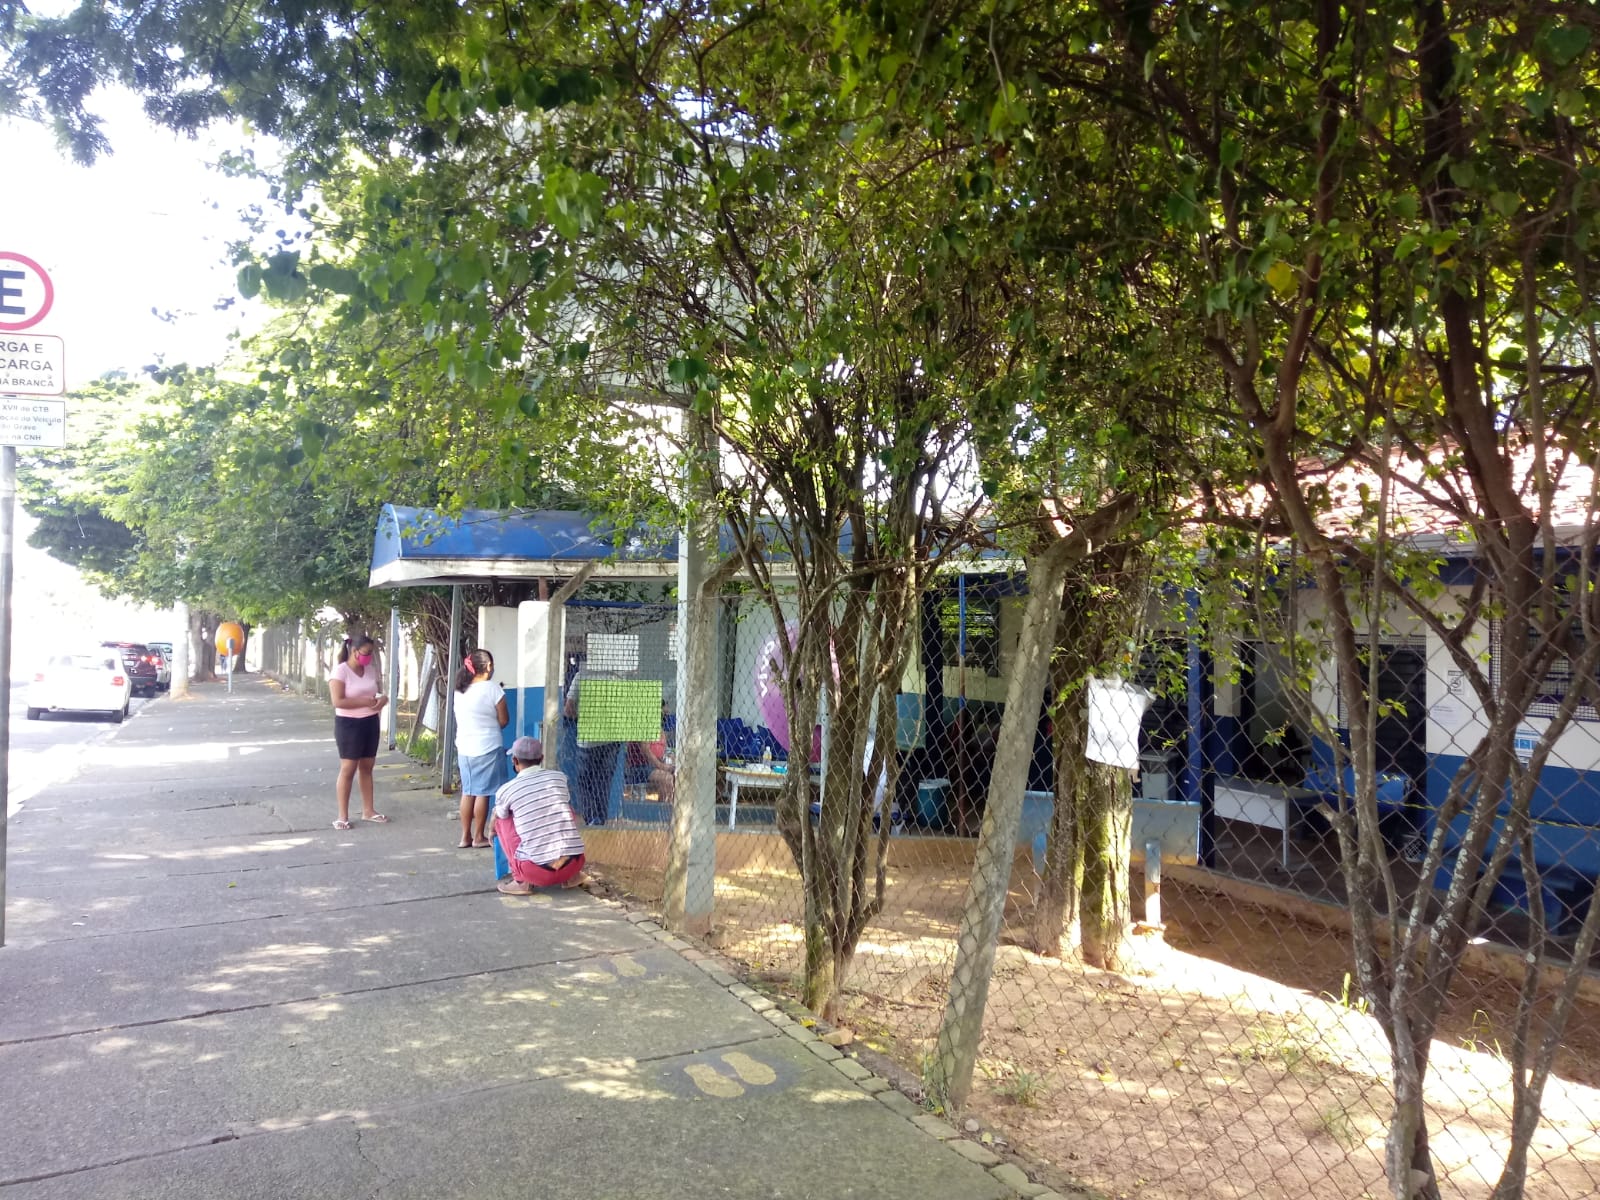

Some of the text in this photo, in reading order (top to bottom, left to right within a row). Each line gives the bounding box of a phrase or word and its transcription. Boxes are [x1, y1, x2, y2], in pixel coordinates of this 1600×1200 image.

[0, 270, 25, 315] E
[34, 343, 43, 353] E
[12, 378, 54, 387] BRANCA
